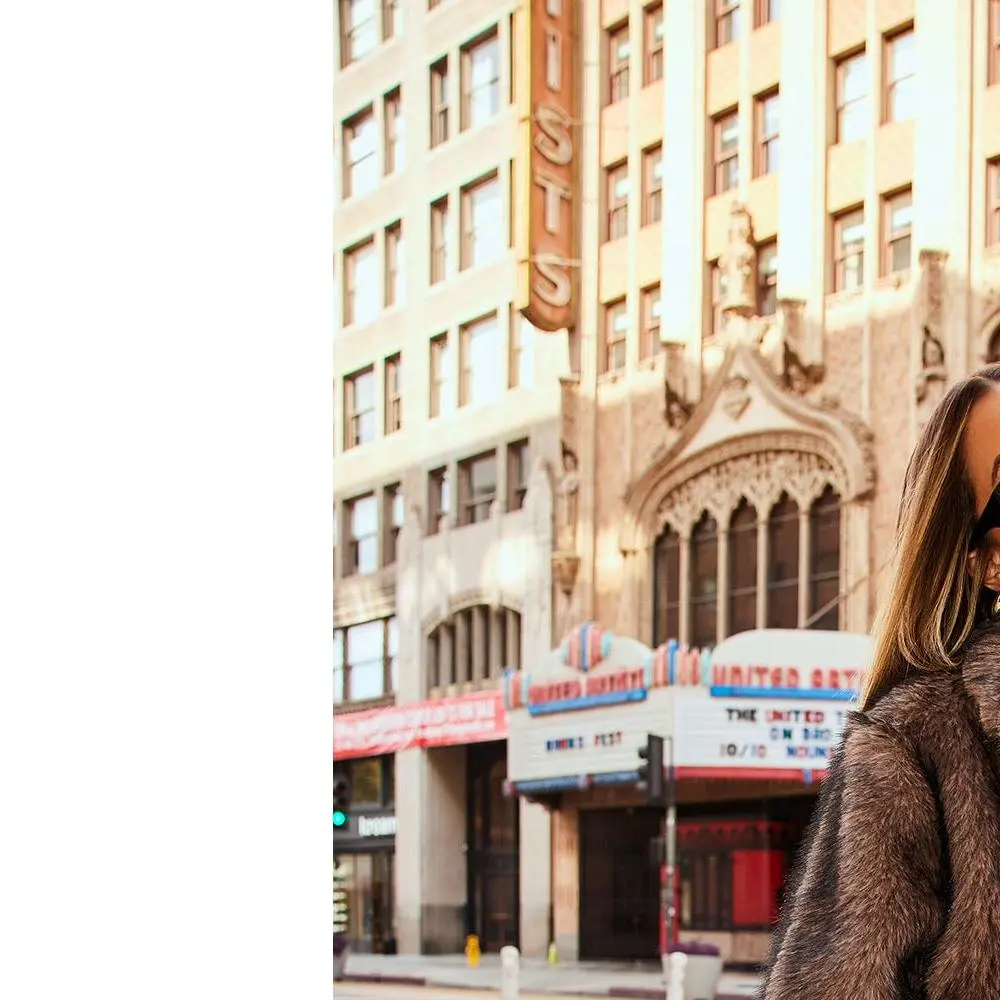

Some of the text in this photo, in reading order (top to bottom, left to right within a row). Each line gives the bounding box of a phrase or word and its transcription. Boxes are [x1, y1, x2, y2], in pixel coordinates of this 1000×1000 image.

[534, 0, 573, 307] ISTS
[712, 664, 800, 688] UNITED
[726, 707, 758, 722] THE
[765, 709, 825, 724] UNITED
[769, 727, 833, 741] ON BRO
[719, 743, 767, 758] 10/10
